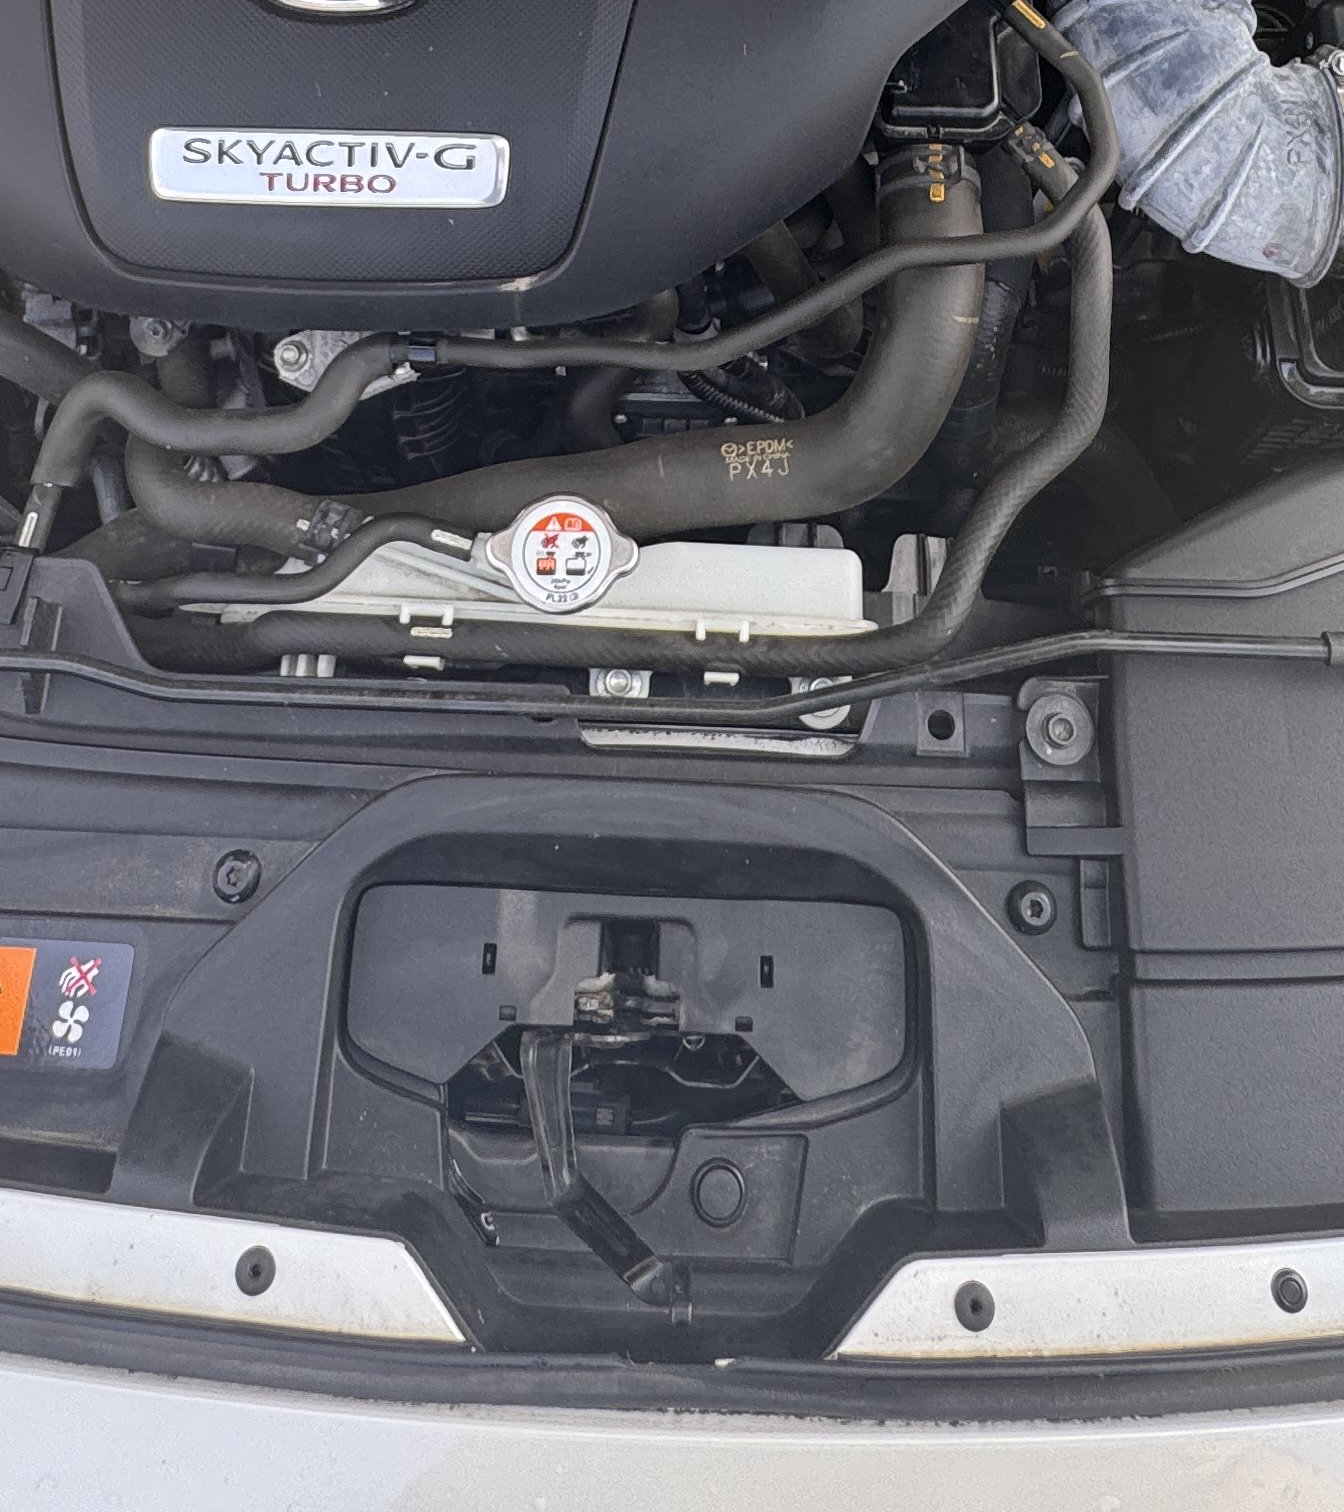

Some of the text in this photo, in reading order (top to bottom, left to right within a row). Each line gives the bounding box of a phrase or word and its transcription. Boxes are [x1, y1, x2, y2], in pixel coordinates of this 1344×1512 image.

[182, 138, 477, 171] SKYACTIV-G
[259, 172, 397, 194] TURBO
[48, 1045, 82, 1058] (PE01)
